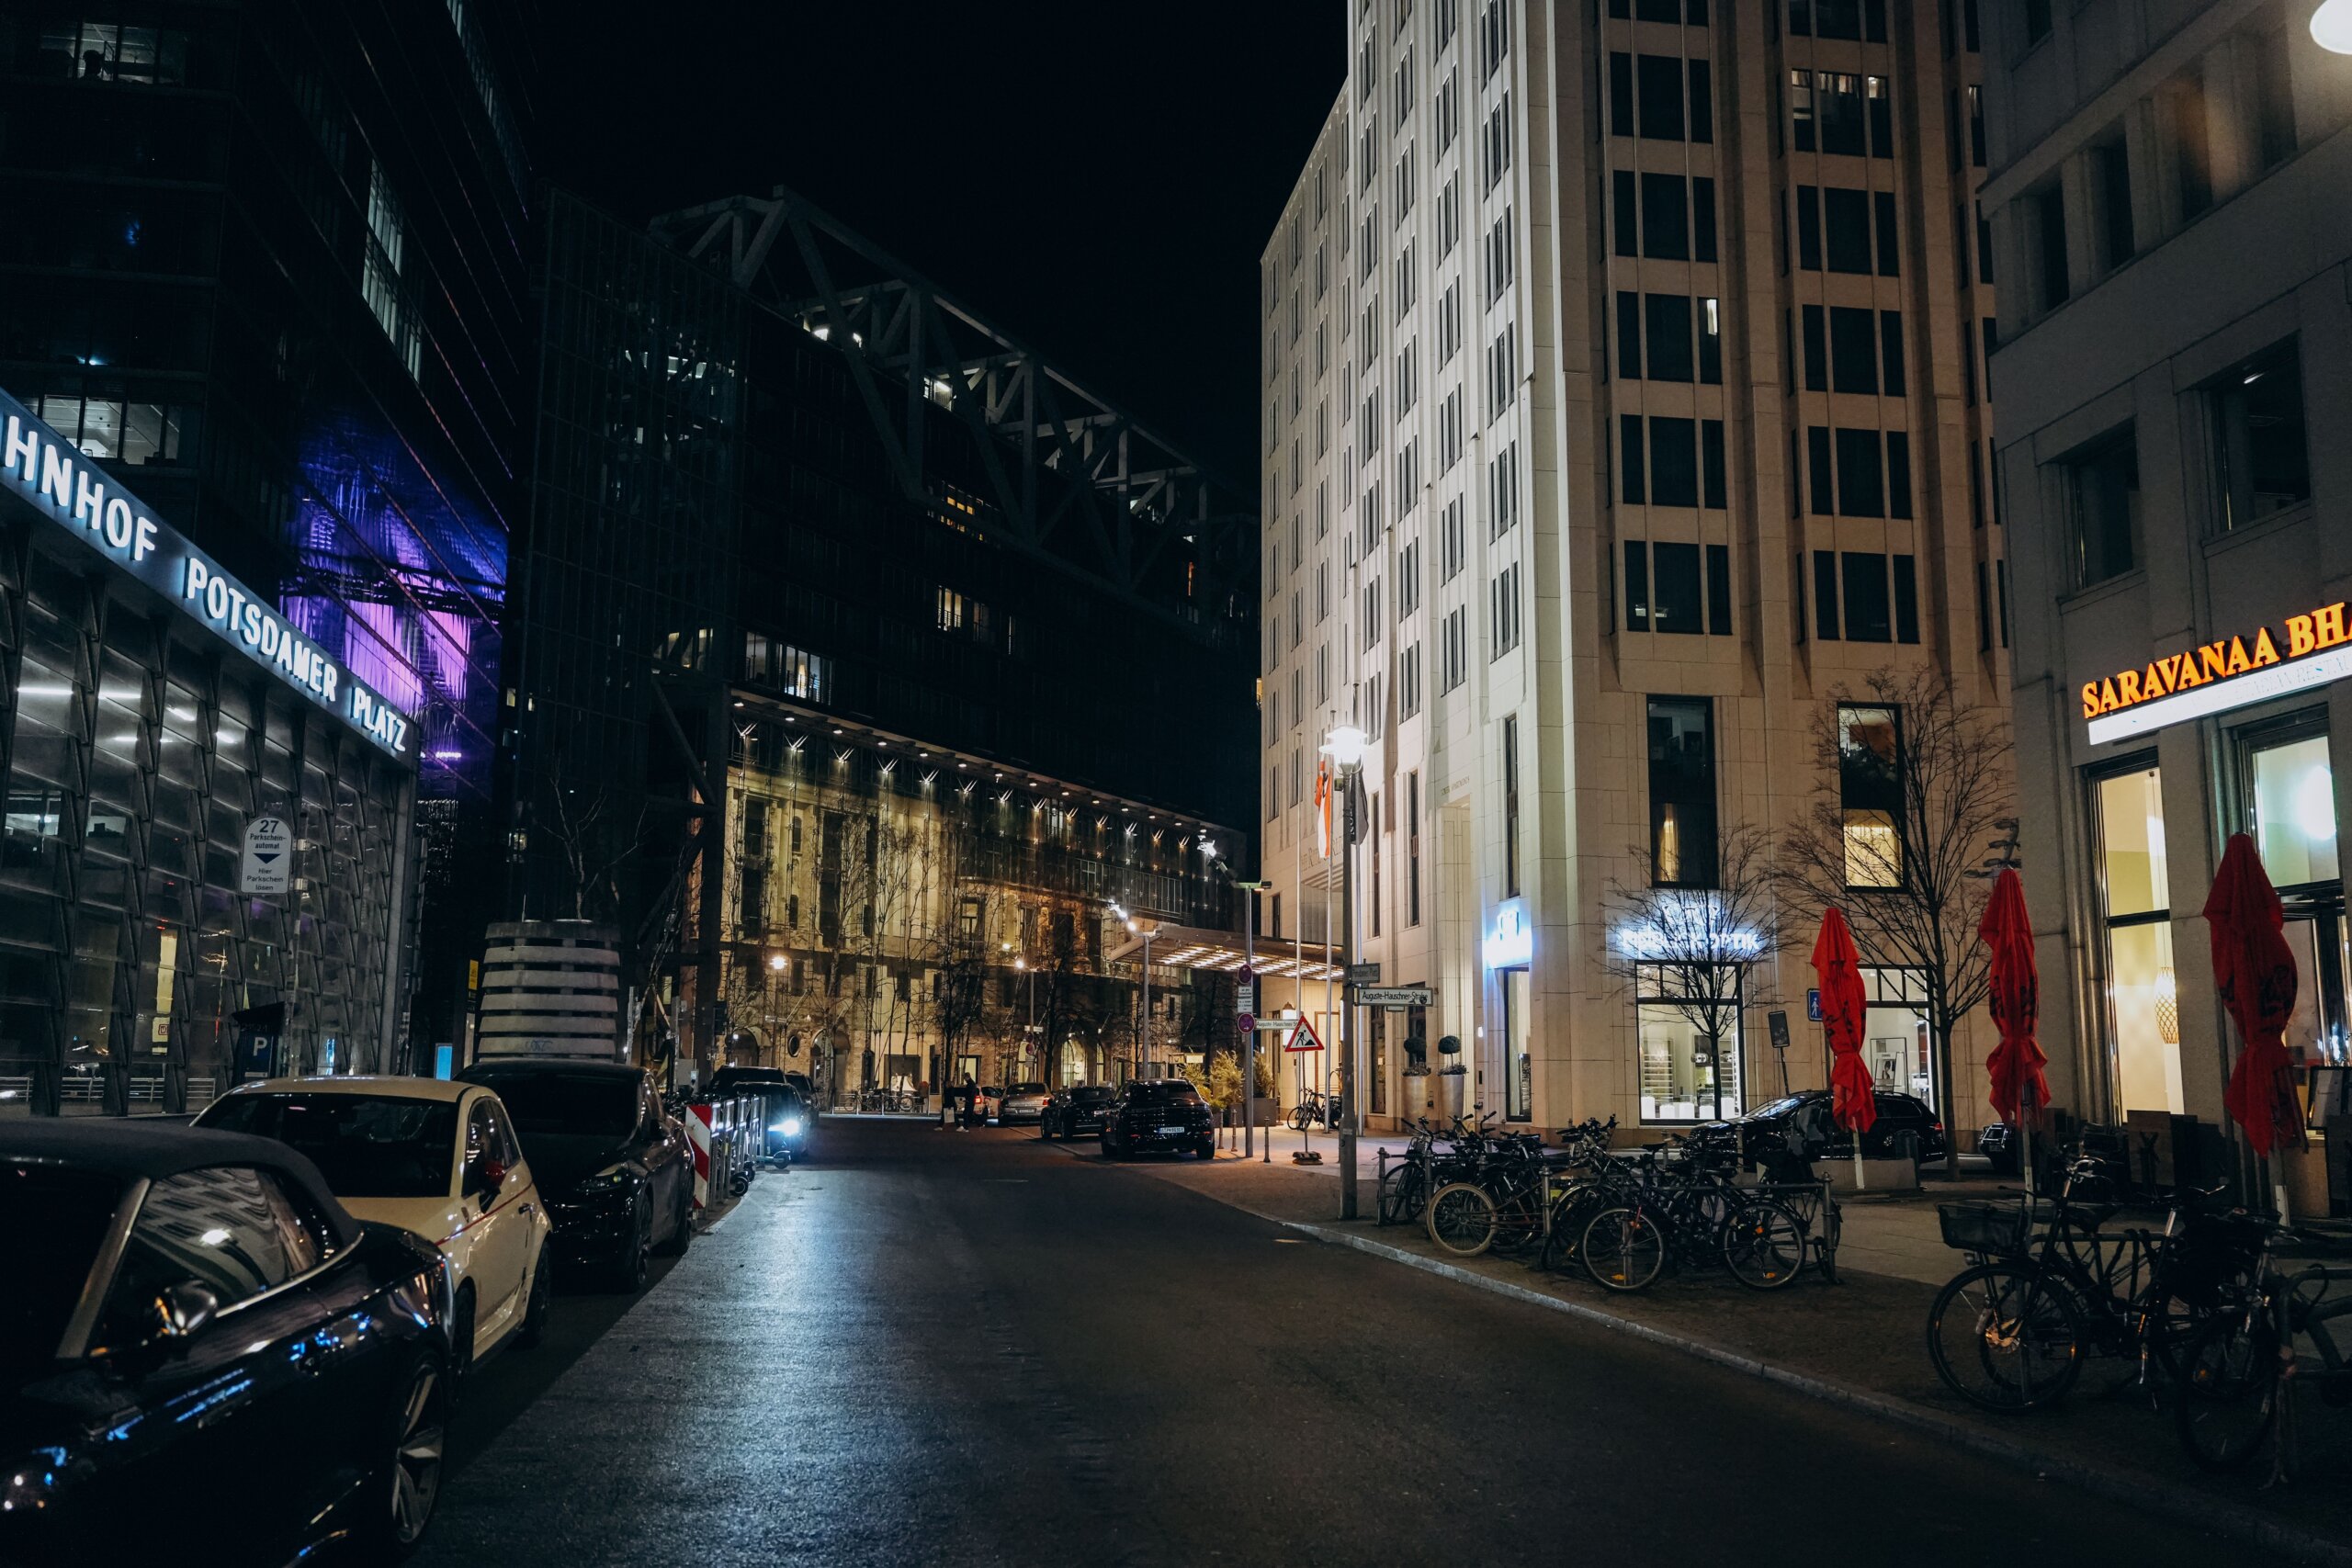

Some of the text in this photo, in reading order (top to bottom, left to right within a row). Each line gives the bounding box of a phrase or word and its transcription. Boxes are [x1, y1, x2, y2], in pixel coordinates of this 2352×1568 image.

[5, 415, 406, 752] HNHOF POTSDAMER PLATZ
[2082, 626, 2280, 719] SARAVANAA
[2284, 602, 2352, 658] BH
[259, 819, 279, 833] 27
[253, 1036, 268, 1056] P
